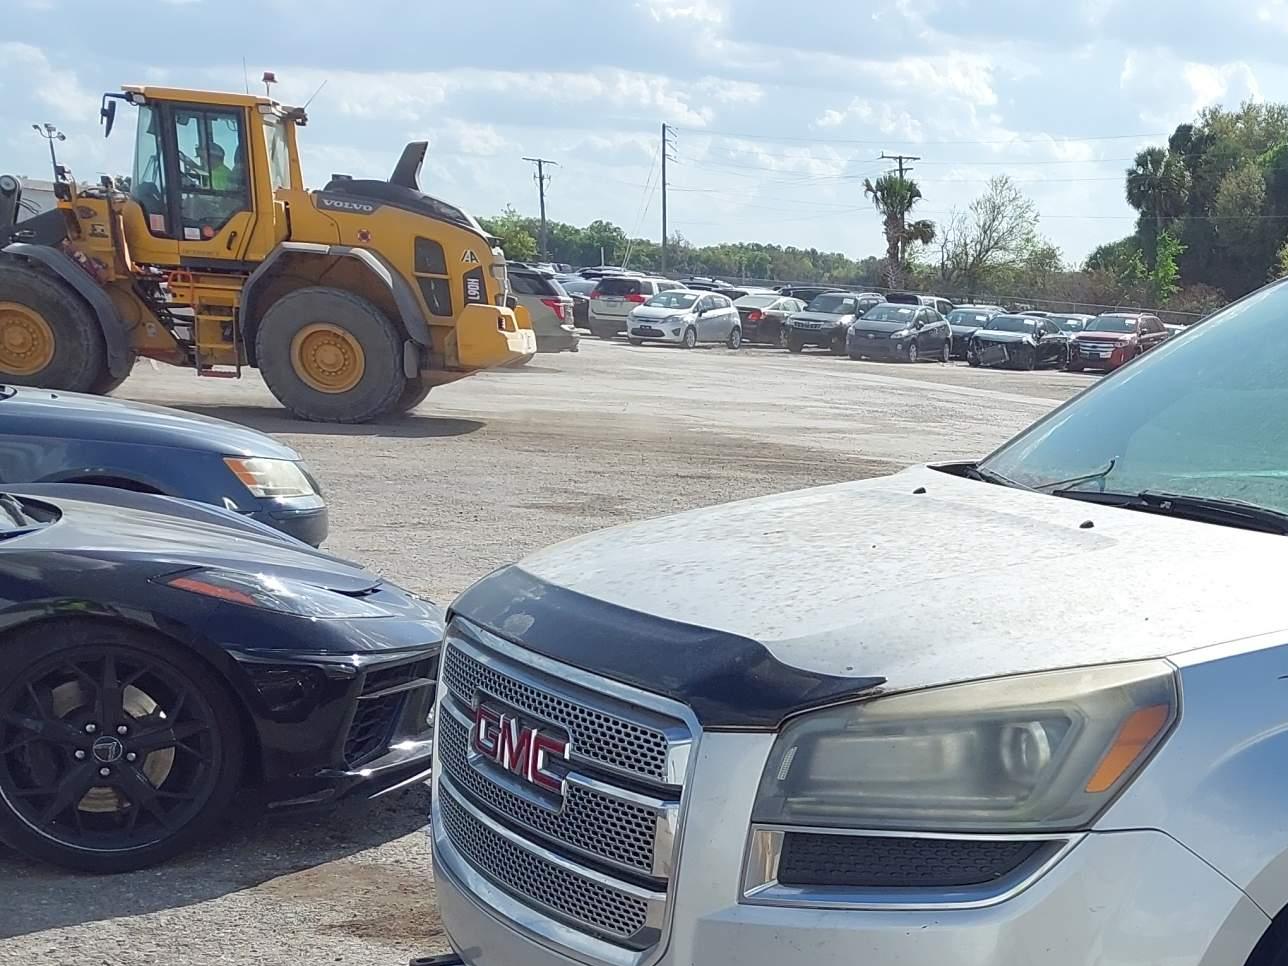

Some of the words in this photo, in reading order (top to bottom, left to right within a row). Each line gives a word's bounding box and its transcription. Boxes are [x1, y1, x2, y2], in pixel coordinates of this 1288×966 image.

[322, 199, 373, 212] VOLVO
[467, 278, 480, 300] L90H
[475, 704, 570, 796] GMC
